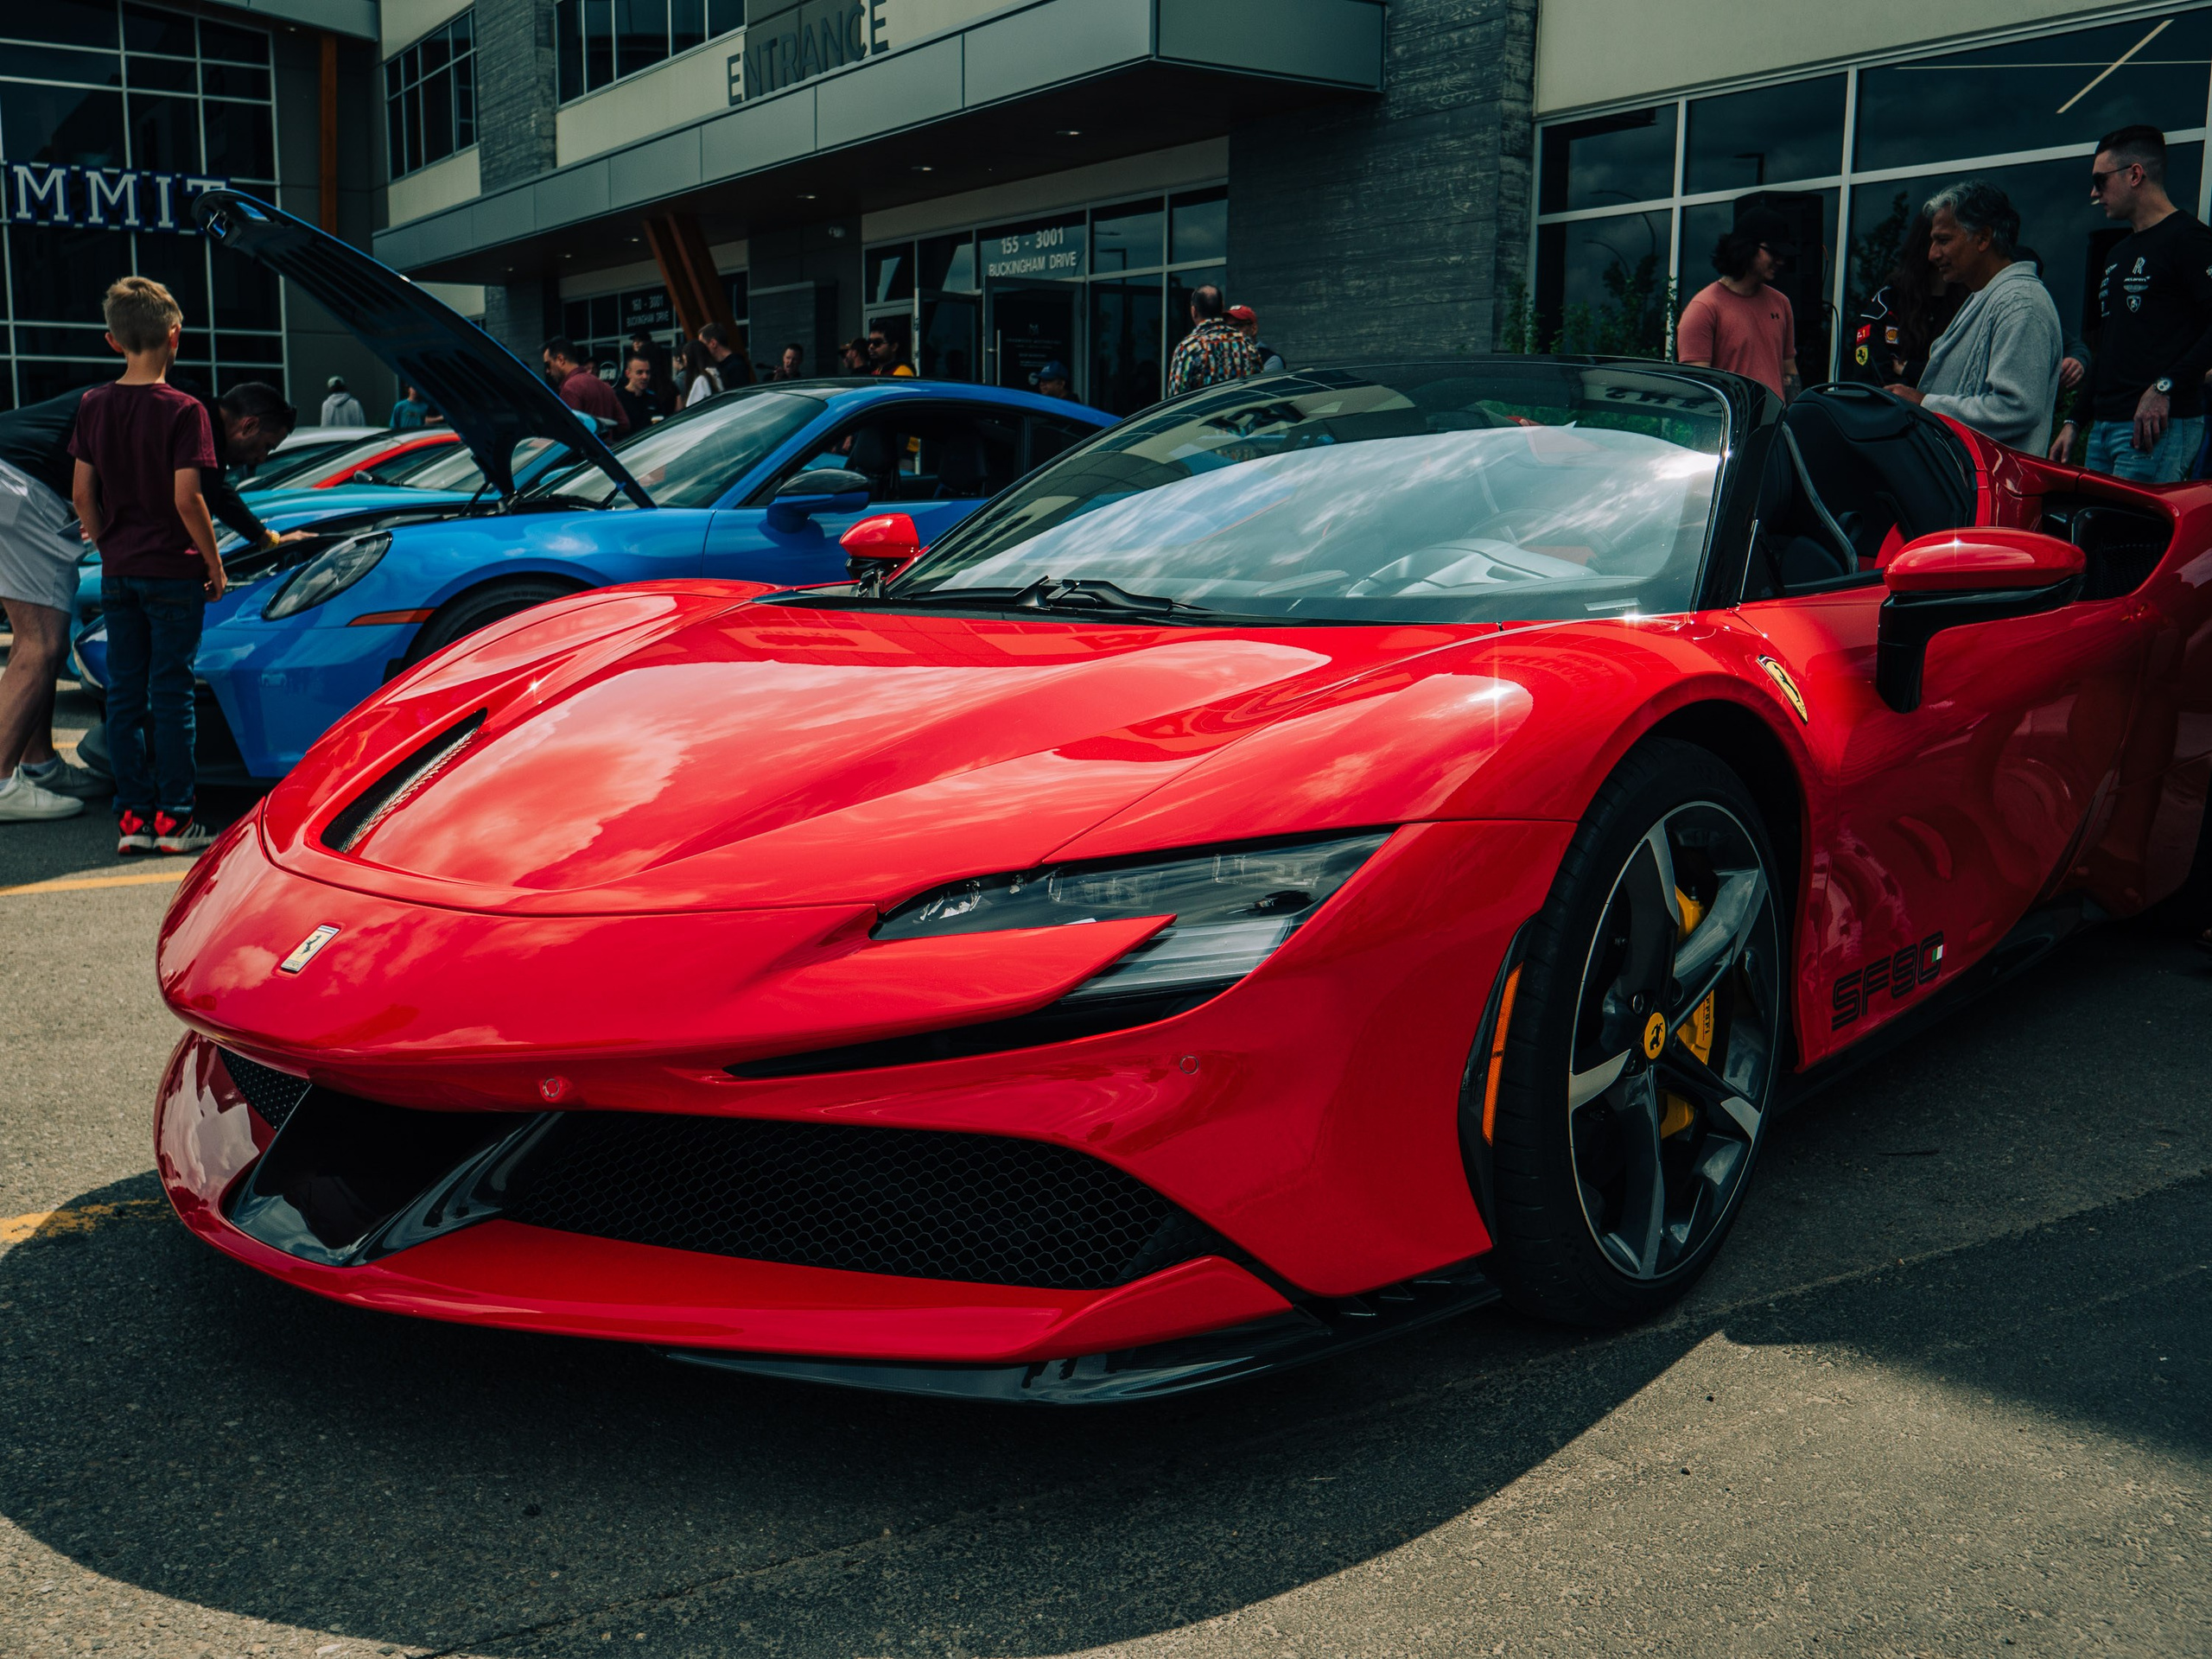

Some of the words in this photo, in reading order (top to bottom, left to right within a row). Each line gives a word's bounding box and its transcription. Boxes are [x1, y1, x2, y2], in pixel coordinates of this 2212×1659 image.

[728, 0, 889, 106] ENTRANCE
[988, 257, 1046, 276] BUCKINGHAM
[1050, 251, 1077, 269] DRIVE
[1001, 236, 1020, 255] 155
[1035, 227, 1064, 249] 3001
[1832, 930, 1943, 1032] SF90
